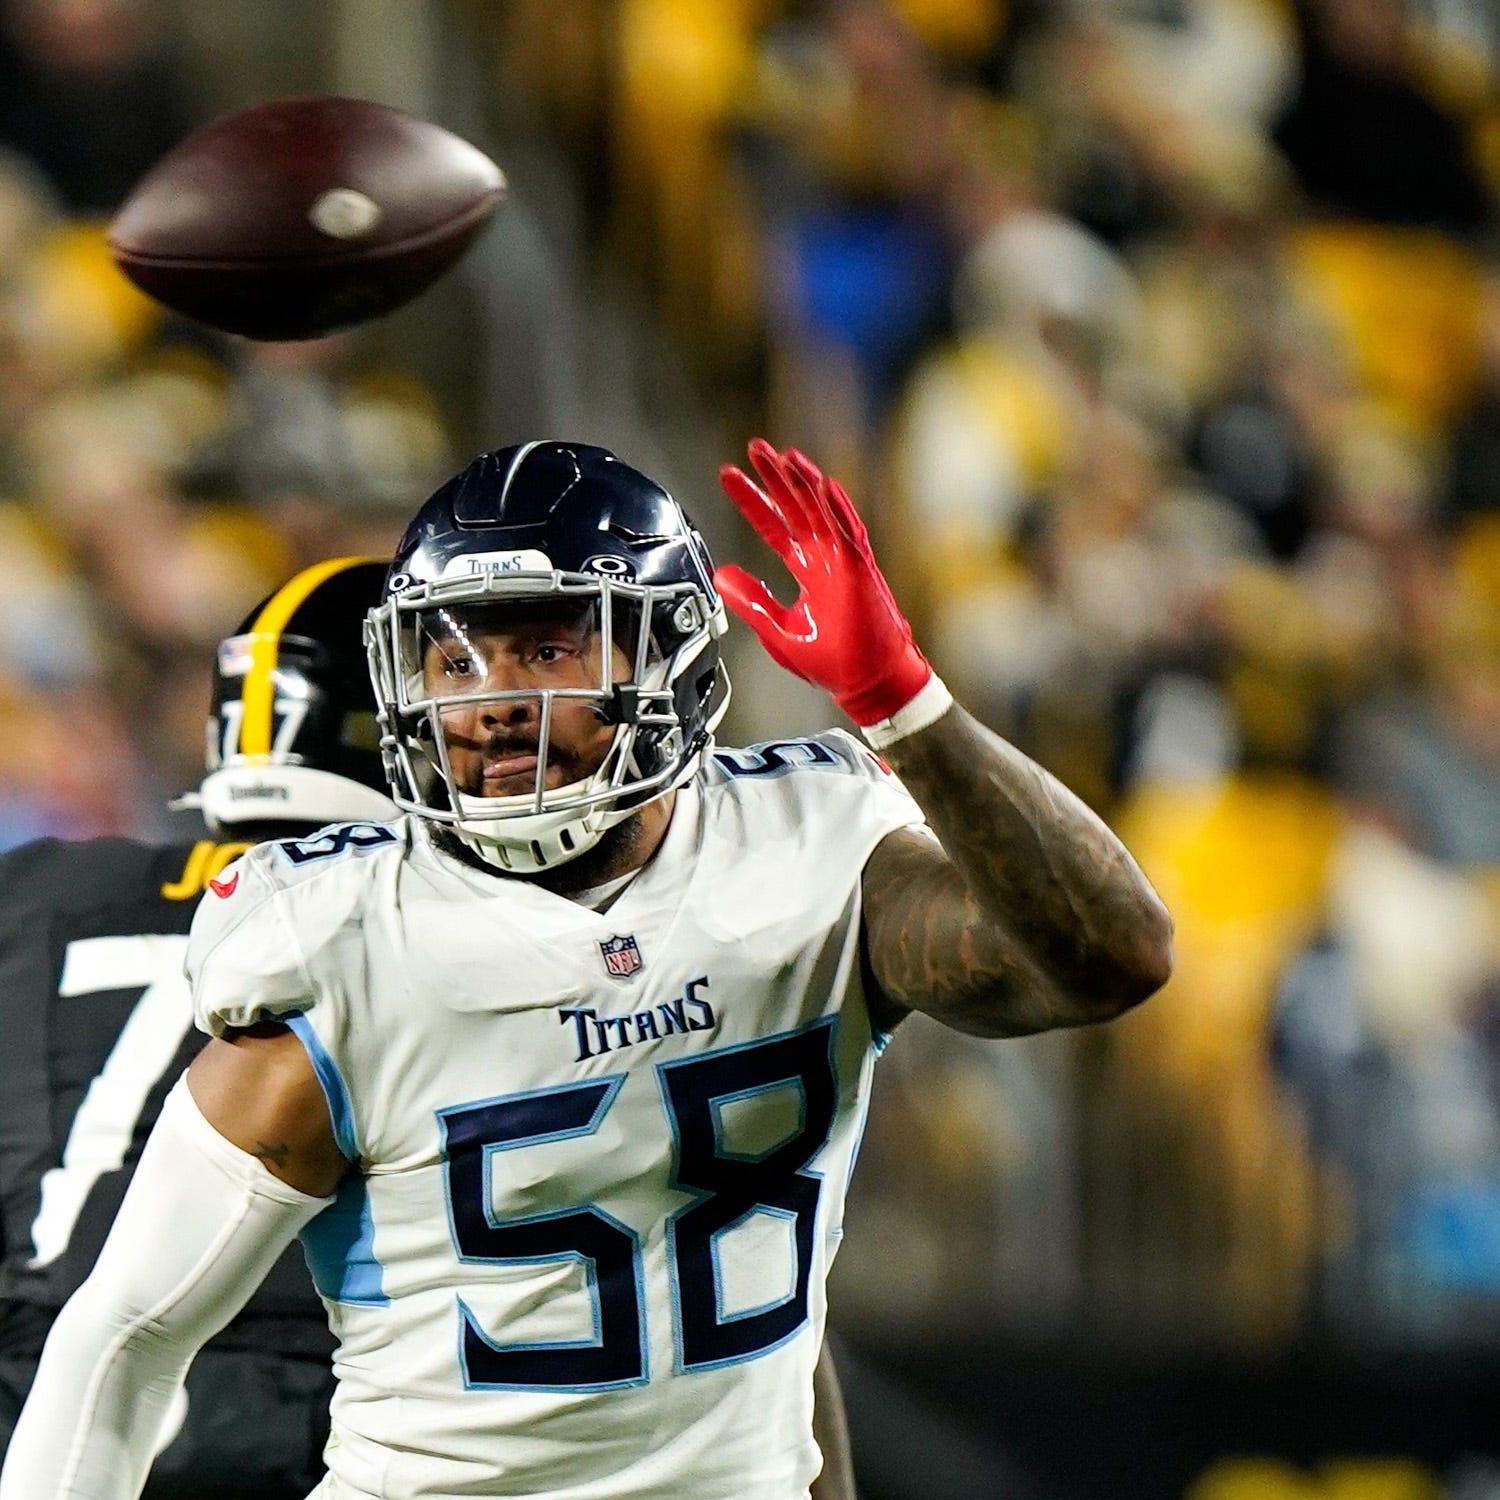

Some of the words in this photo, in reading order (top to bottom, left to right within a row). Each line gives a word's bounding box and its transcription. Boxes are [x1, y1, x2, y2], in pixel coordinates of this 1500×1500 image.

[467, 555, 522, 575] TITANS
[607, 950, 640, 973] NFL
[558, 975, 716, 1064] TITANS
[30, 933, 198, 1271] 7
[435, 1013, 838, 1393] 58
